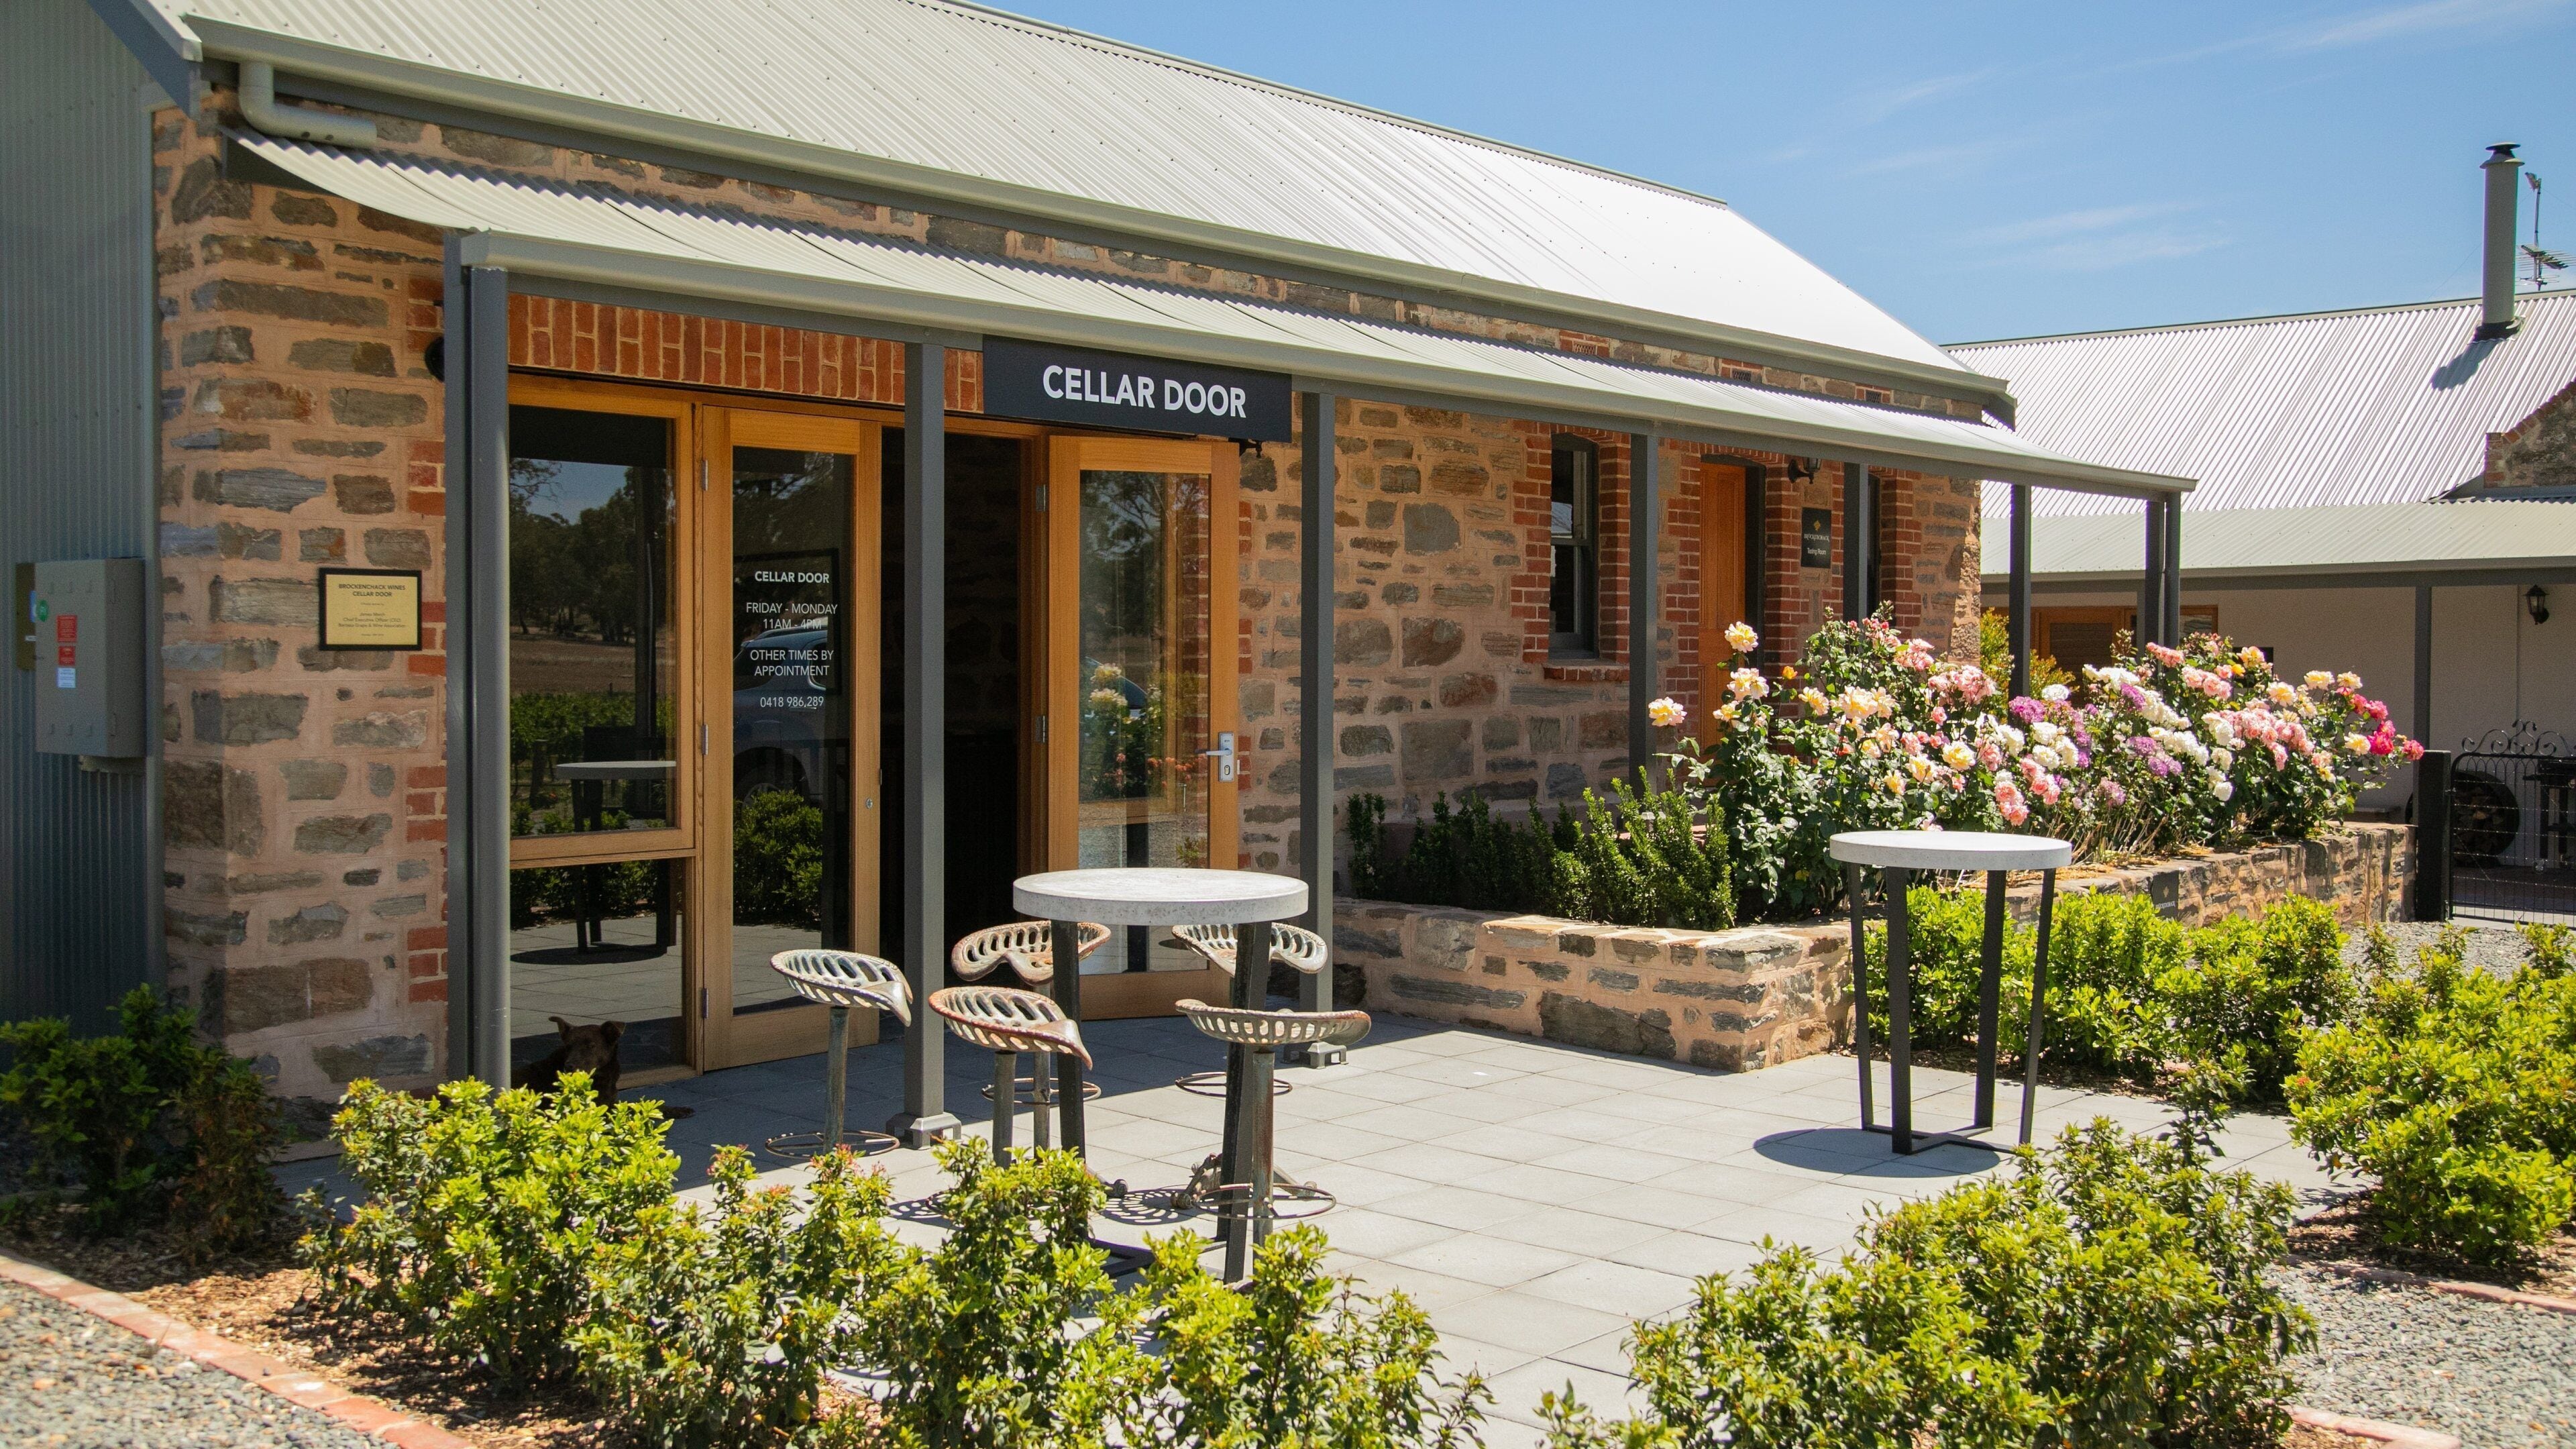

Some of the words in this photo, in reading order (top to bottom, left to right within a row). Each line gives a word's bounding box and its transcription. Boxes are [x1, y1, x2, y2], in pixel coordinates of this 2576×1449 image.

[1042, 365, 1155, 409] CELLAR
[1164, 379, 1246, 418] DOOR
[755, 571, 795, 582] CELLAR
[798, 573, 829, 583] DOOR
[746, 602, 783, 613] FRIDAY
[792, 603, 838, 614] MONDAY
[763, 619, 792, 629] 11AM
[800, 619, 822, 629] 4PM
[750, 650, 786, 660] OTHER
[788, 650, 818, 661] TIMES
[821, 650, 834, 661] BY
[754, 665, 830, 676] APPOINTMENT
[760, 697, 784, 708] 0418
